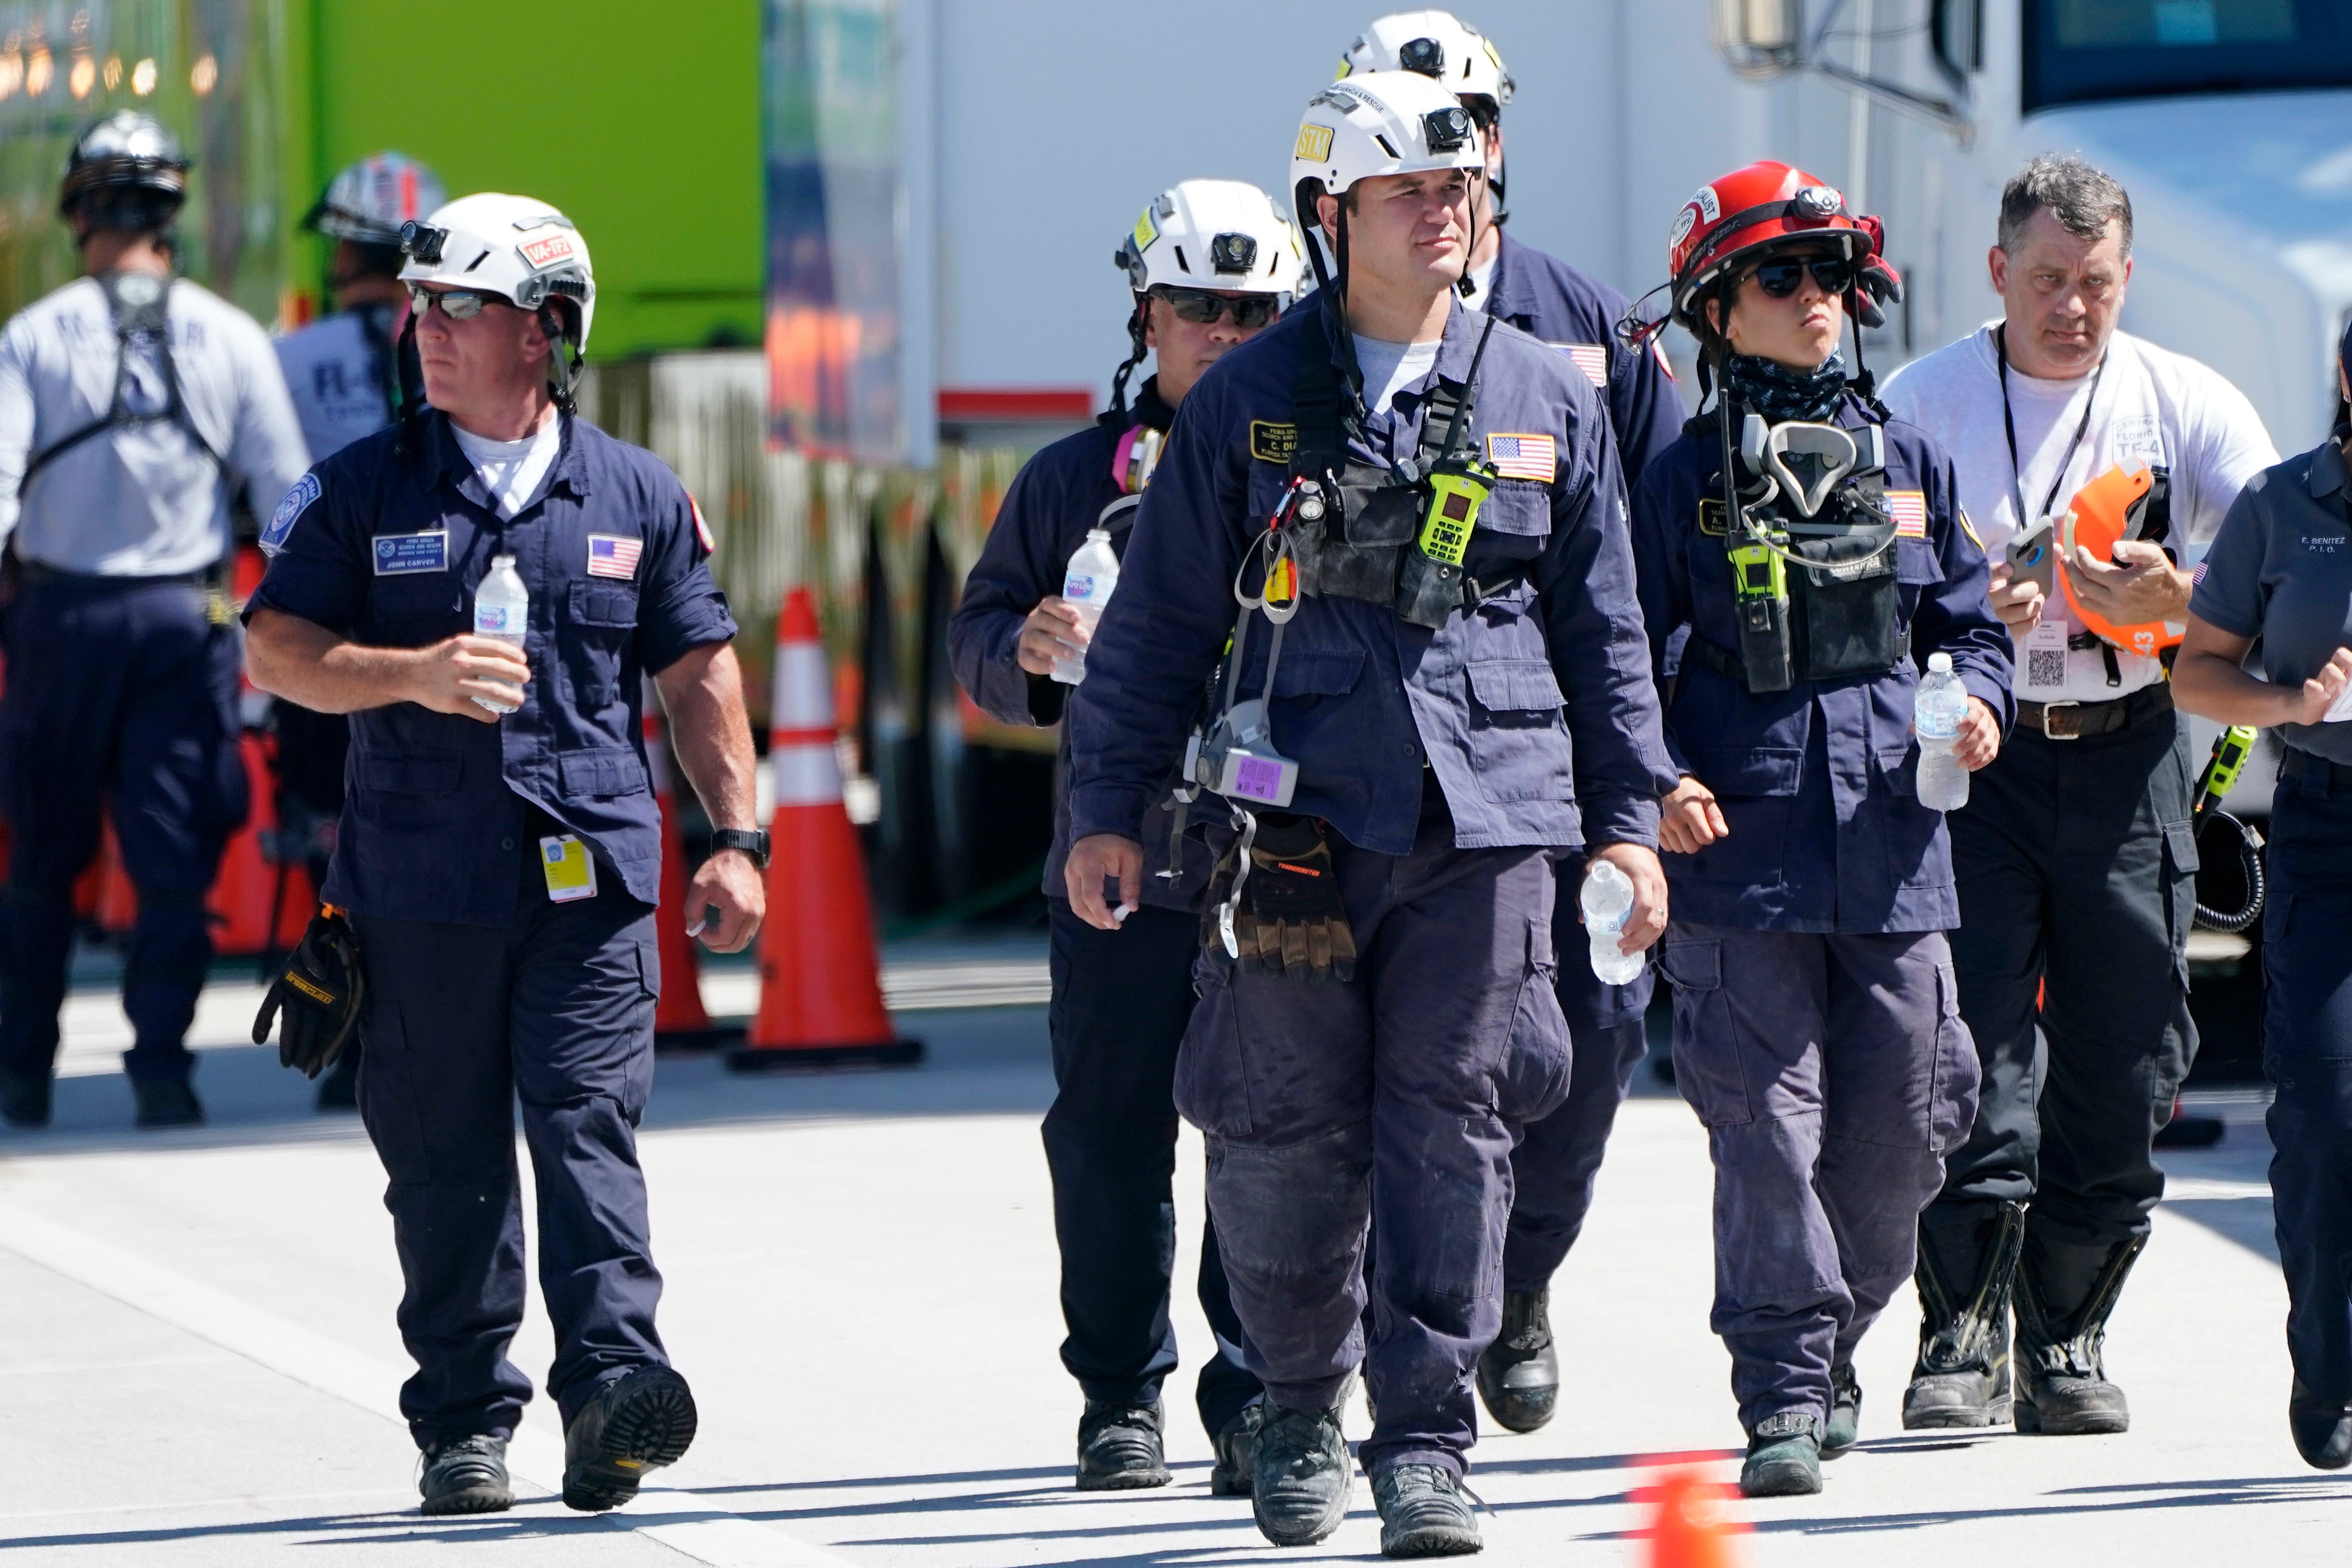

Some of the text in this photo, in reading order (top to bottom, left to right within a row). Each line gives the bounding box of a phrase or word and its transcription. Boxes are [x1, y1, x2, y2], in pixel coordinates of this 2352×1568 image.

[1363, 94, 1384, 114] RESCUE
[1299, 128, 1329, 158] STM
[528, 238, 570, 261] VA-TF2
[2116, 418, 2154, 431] CENTRA
[2117, 430, 2153, 441] FLORID
[1271, 442, 1280, 450] C.
[2117, 439, 2160, 457] TF-4
[2311, 537, 2346, 545] BENITEZ
[387, 559, 435, 569] JOHN CARVER
[2134, 631, 2154, 659] 43
